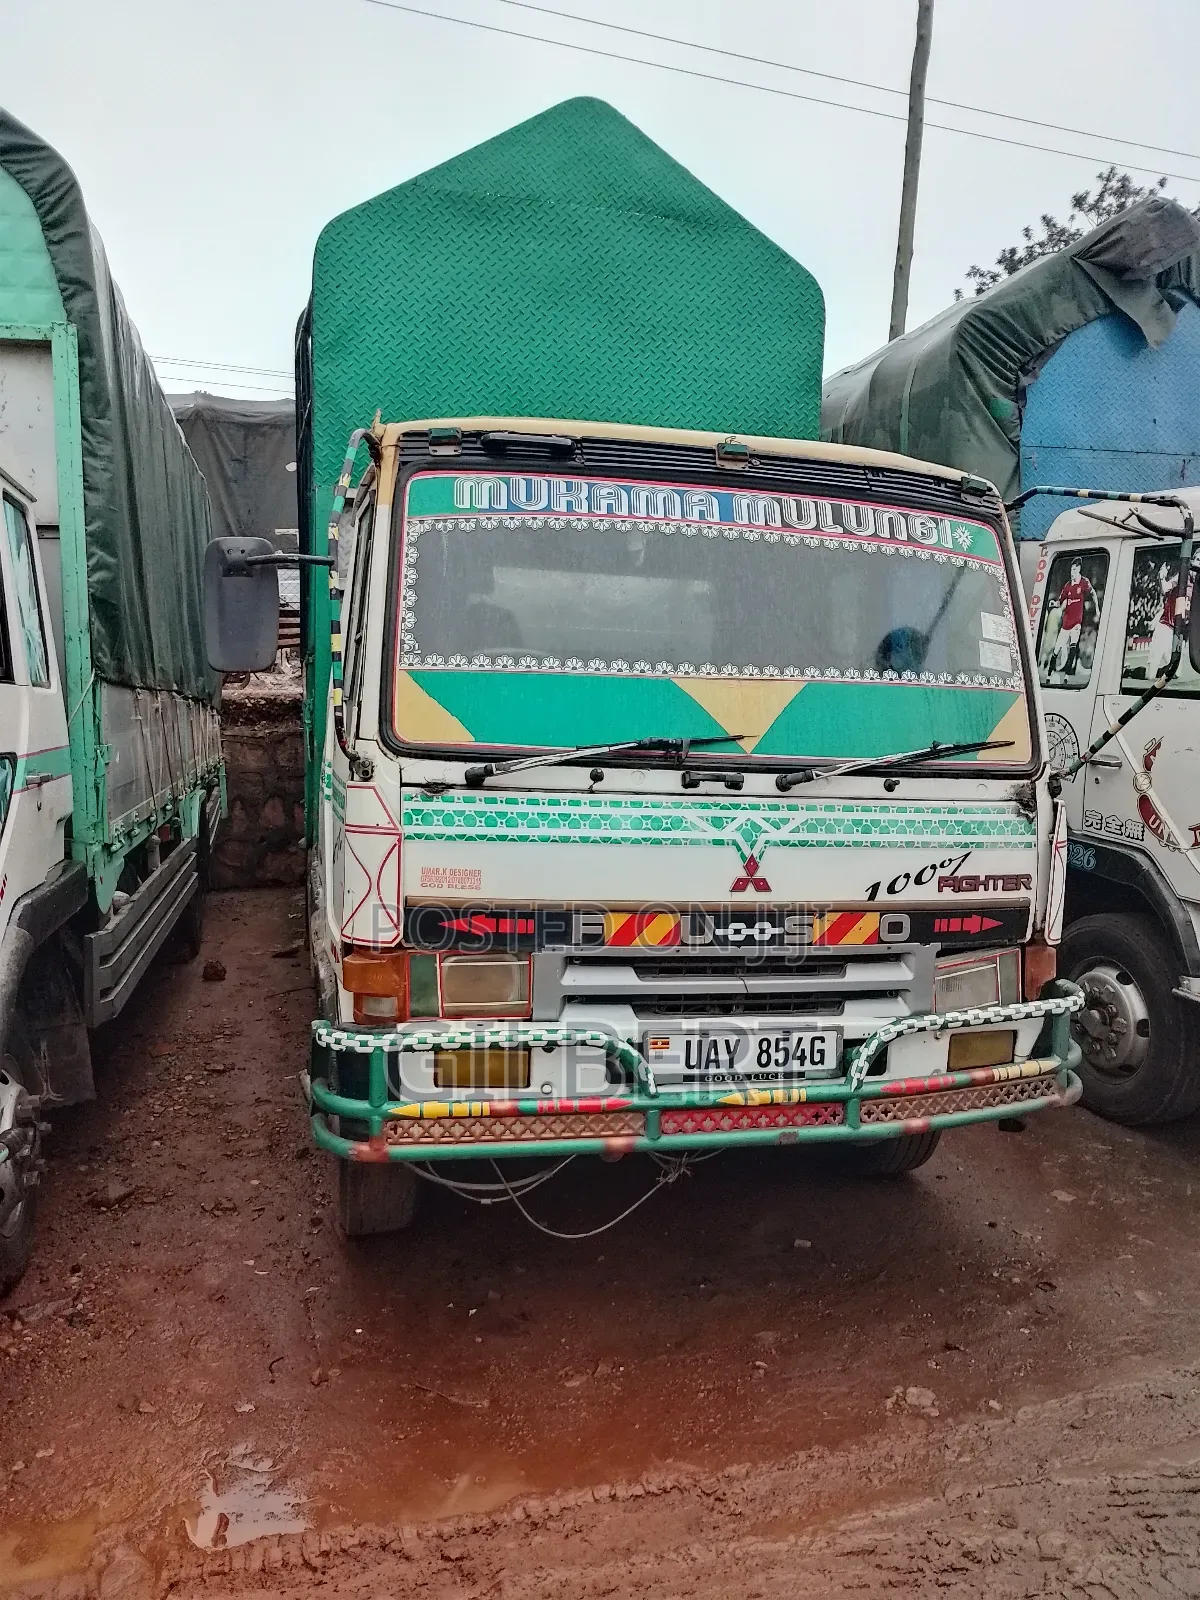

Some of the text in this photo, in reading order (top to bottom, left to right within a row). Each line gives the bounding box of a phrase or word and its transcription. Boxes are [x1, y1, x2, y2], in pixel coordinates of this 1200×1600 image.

[449, 869, 482, 878] DESIGNER
[937, 873, 1033, 893] FIGHTER
[685, 1035, 826, 1070] UAY 854G
[704, 1072, 785, 1082] GOOD LUCK
